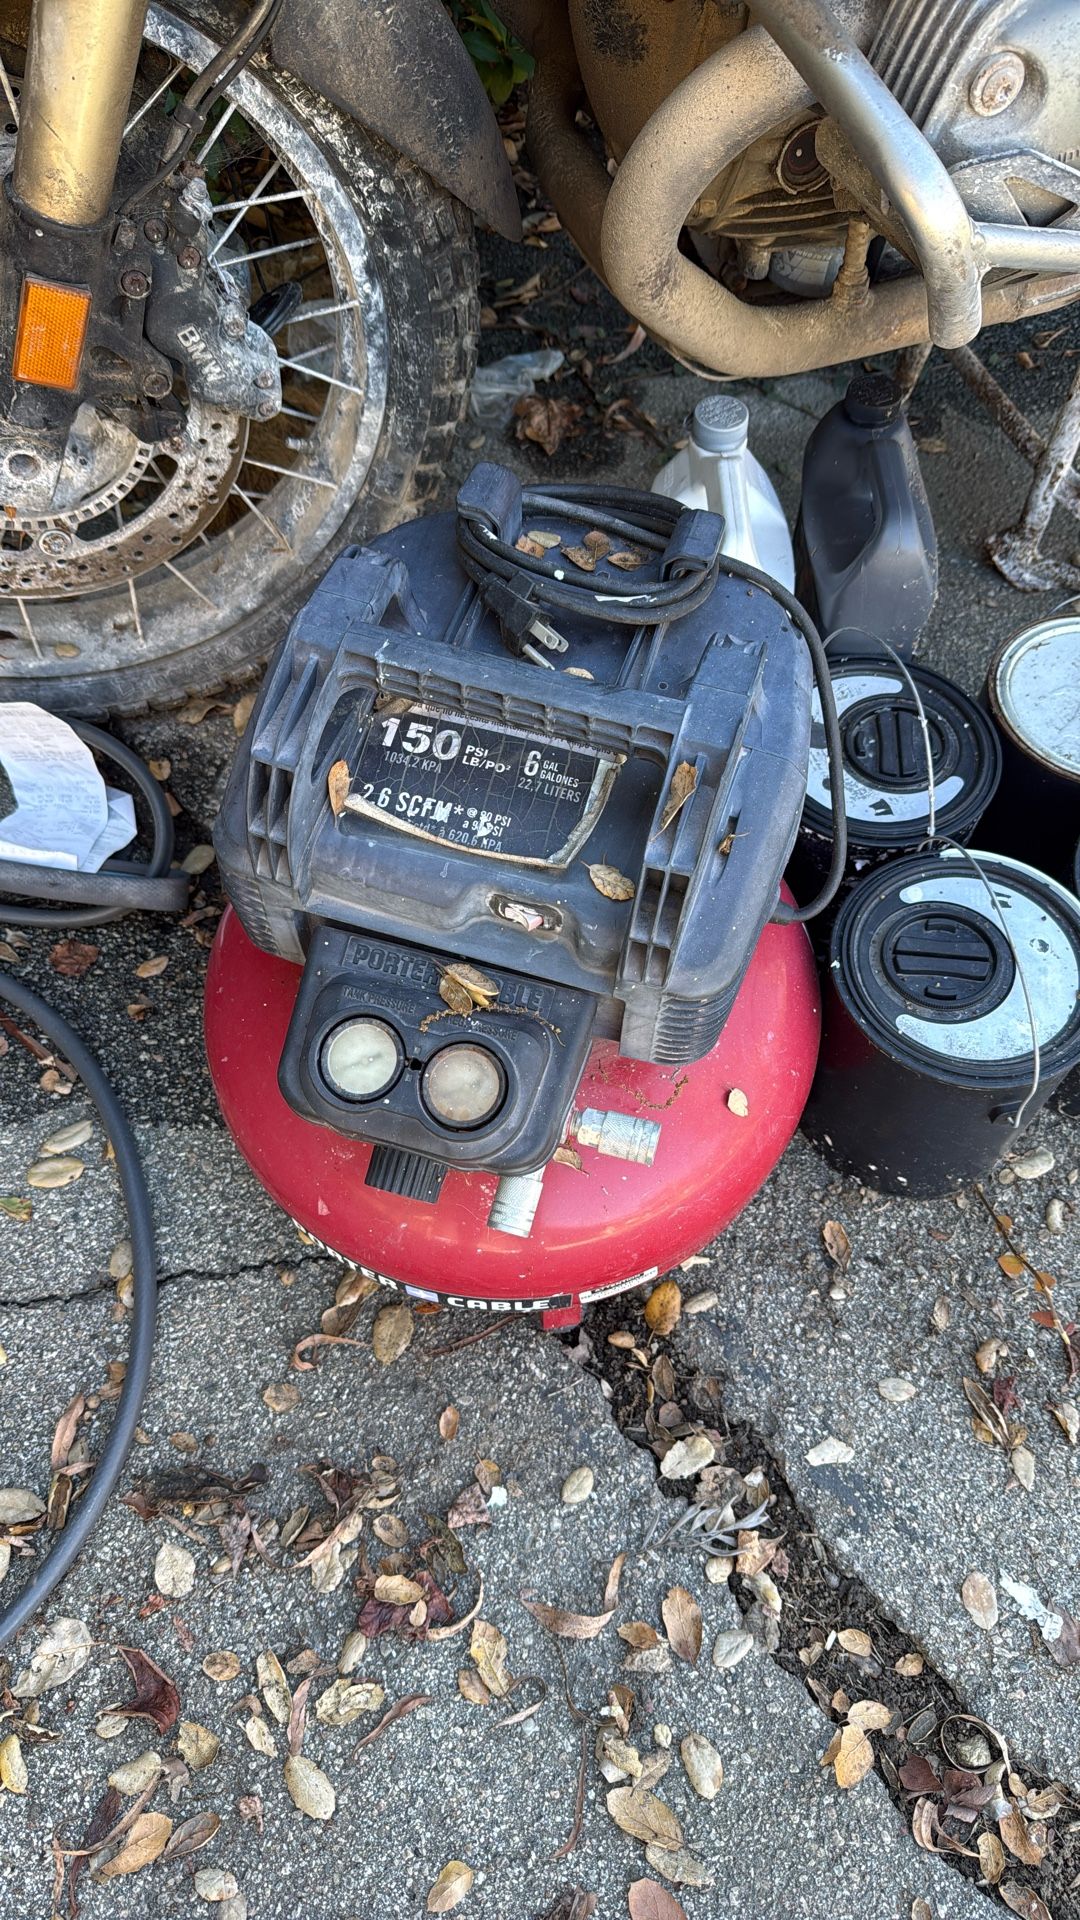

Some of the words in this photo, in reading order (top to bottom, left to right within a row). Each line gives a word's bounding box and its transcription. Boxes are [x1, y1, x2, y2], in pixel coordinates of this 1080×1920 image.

[177, 325, 226, 382] BMW
[382, 717, 462, 761] 150
[465, 745, 489, 757] PSI
[422, 759, 442, 774] KPA
[524, 750, 542, 777] 6
[543, 760, 559, 772] GAL
[540, 770, 580, 788] GALONES
[543, 783, 582, 803] LITERS
[494, 814, 512, 828] PSI
[352, 943, 440, 986] PORTER
[342, 986, 369, 1003] TANK
[369, 993, 417, 1015] PRESSURE
[447, 1296, 550, 1313] CABLE
